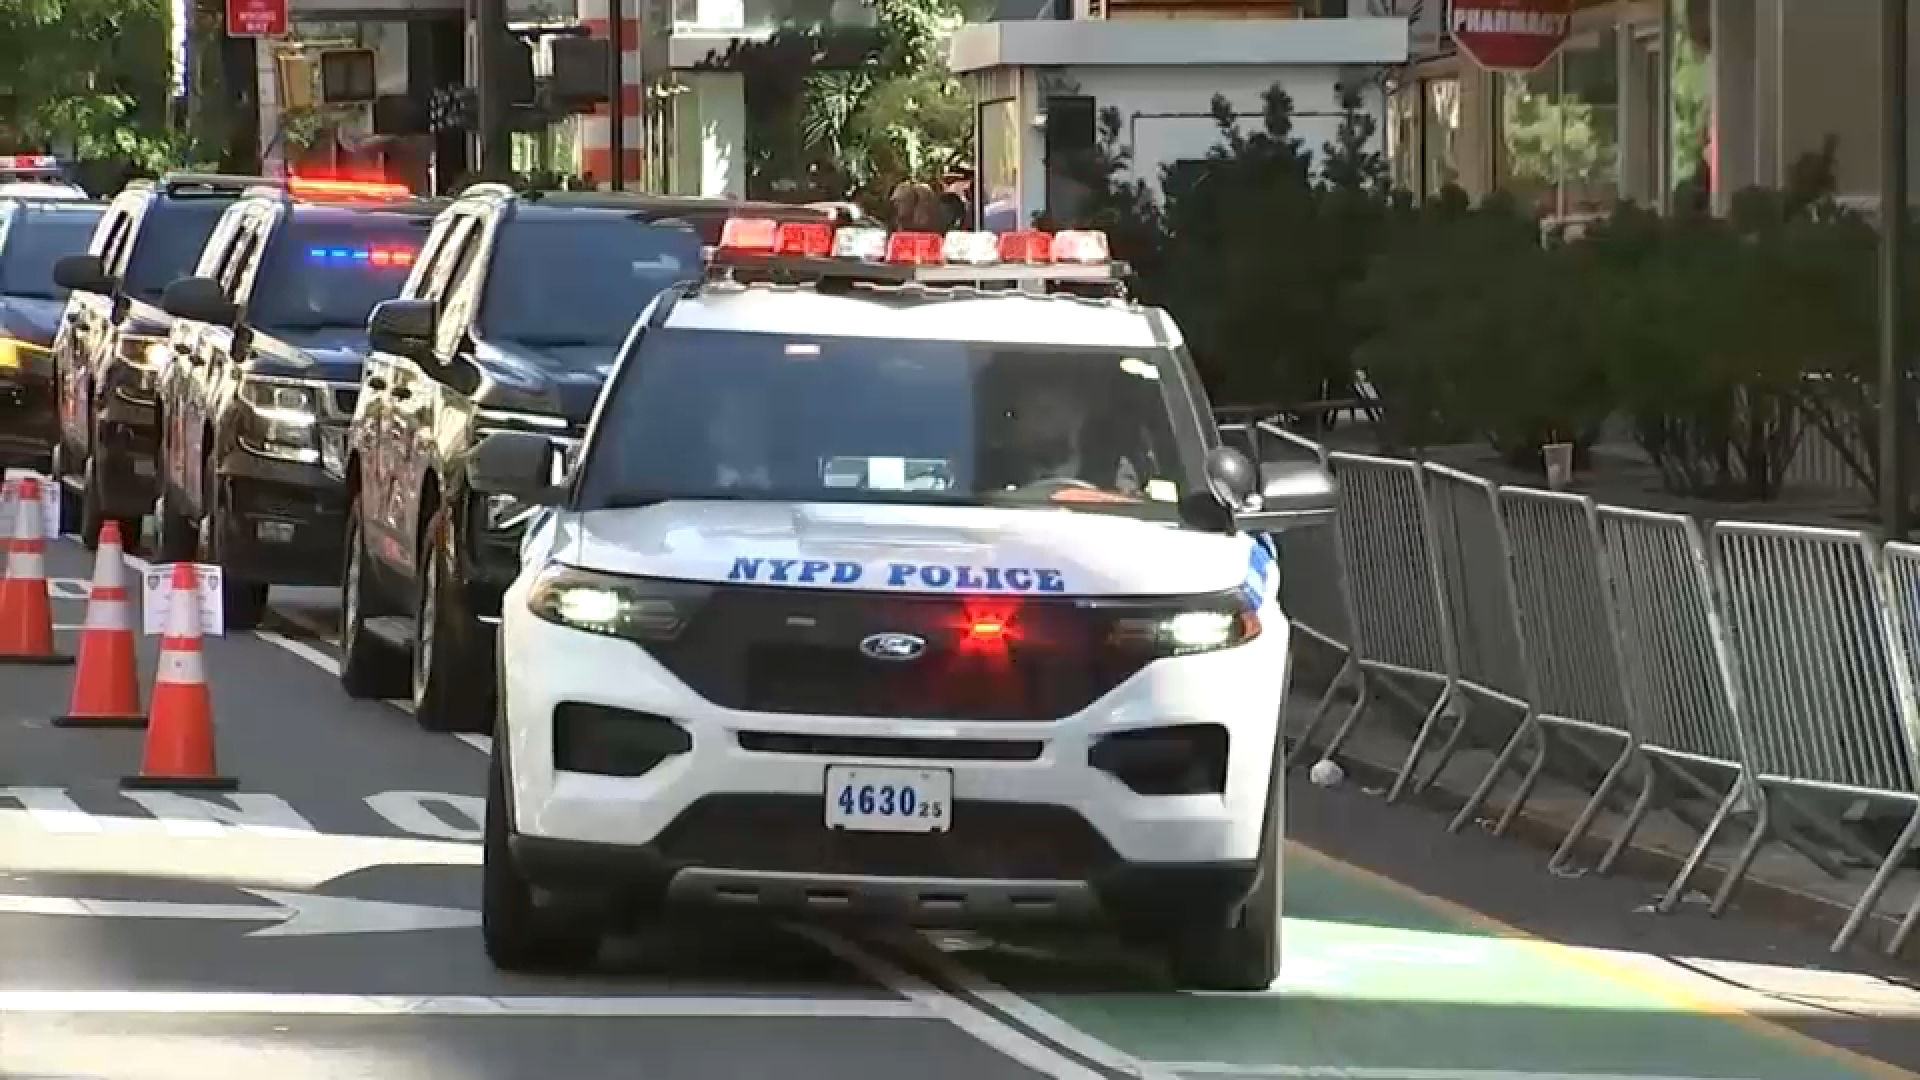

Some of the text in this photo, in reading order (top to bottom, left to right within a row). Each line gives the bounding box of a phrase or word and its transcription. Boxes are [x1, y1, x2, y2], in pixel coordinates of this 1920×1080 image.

[1453, 9, 1570, 34] PHARMACY
[728, 557, 1065, 592] NYPD POLICE
[838, 784, 943, 819] 4630 25
